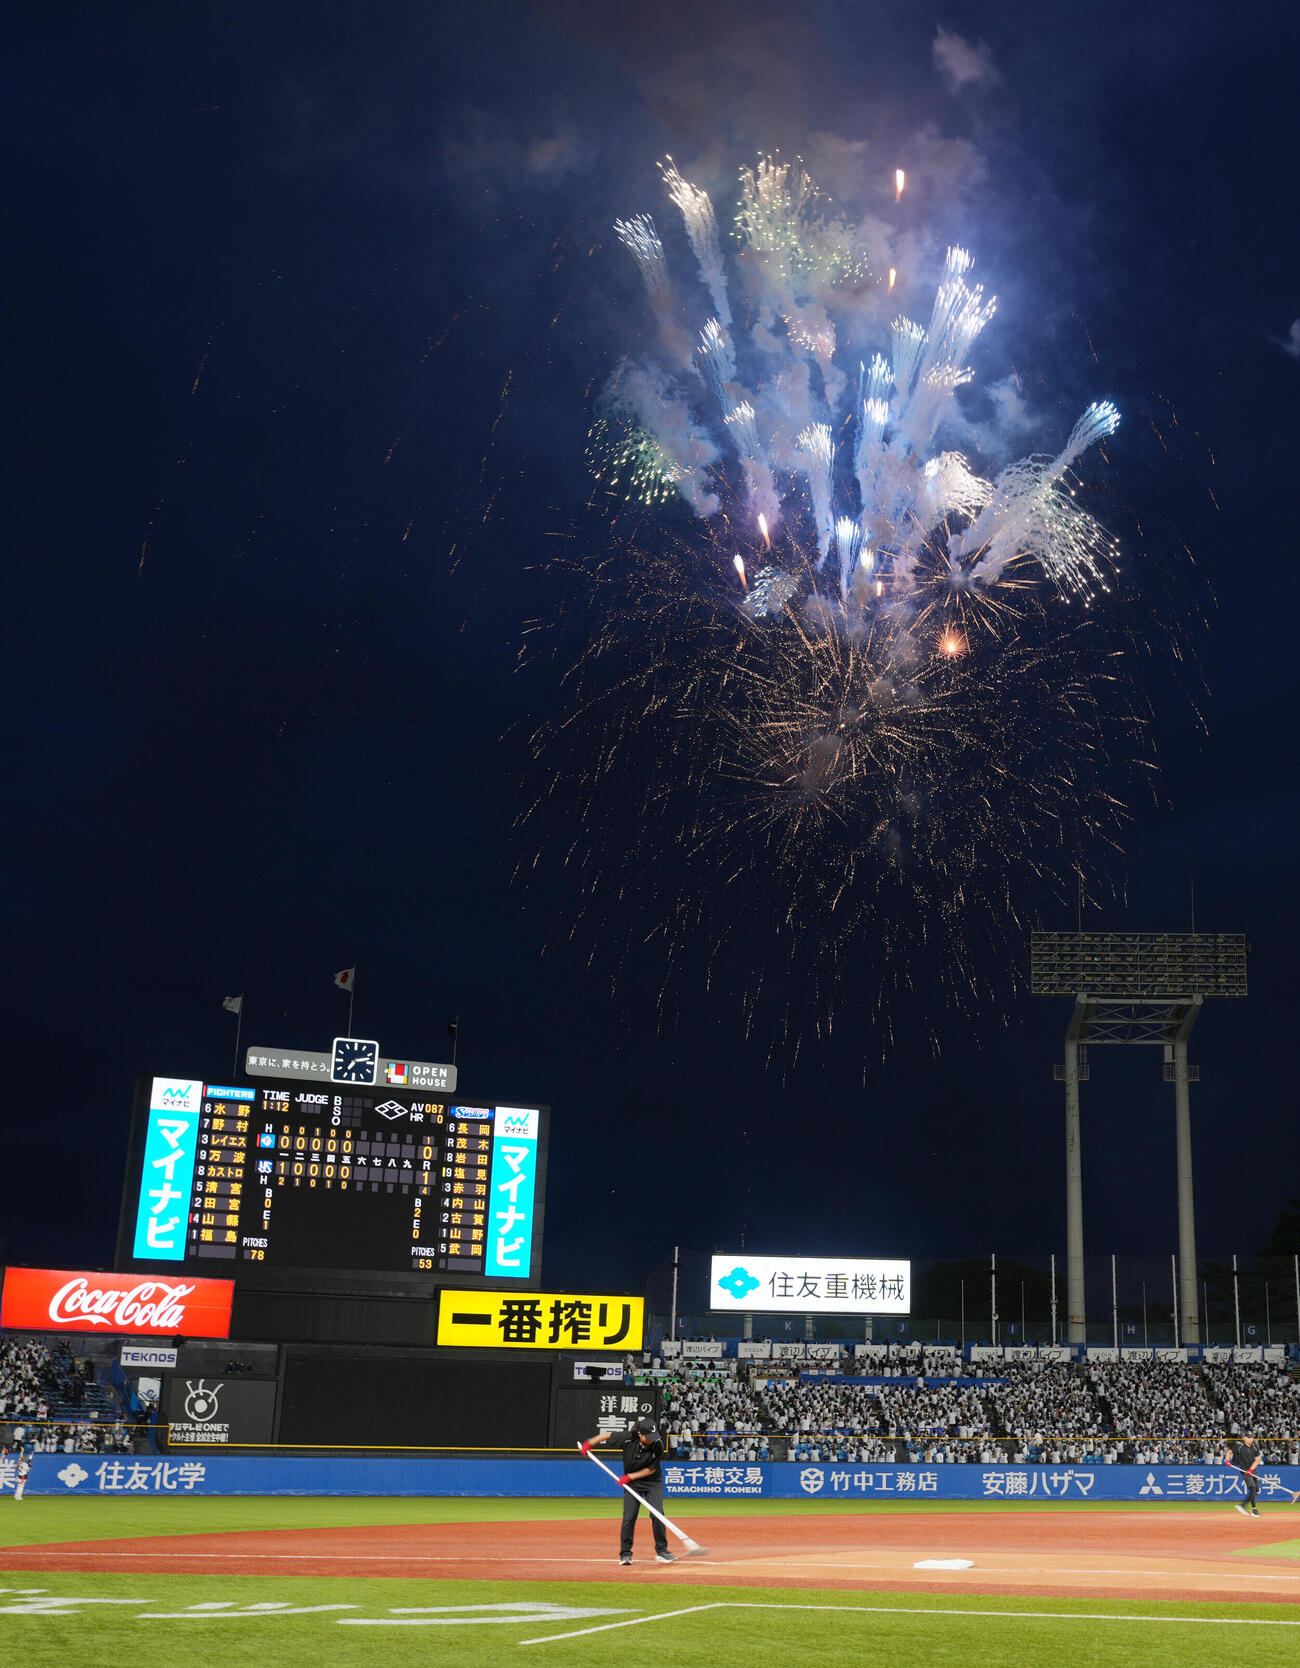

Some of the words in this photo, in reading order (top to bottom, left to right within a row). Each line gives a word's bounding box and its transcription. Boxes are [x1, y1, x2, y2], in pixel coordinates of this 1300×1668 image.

[412, 1065, 448, 1078] OPEN
[412, 1076, 447, 1087] HOUSE
[207, 1088, 254, 1099] FIGHTERS
[263, 1090, 290, 1102] TIME
[295, 1093, 329, 1105] JUDGE
[162, 1098, 190, 1108] マイナビ
[263, 1101, 290, 1112] 1:12
[334, 1096, 342, 1106] B
[204, 1103, 212, 1113] 6
[213, 1103, 250, 1117] 水野
[333, 1107, 341, 1116] S
[411, 1103, 424, 1112] AV
[425, 1104, 444, 1114] 087
[410, 1113, 423, 1122] HR
[437, 1115, 443, 1124] 0
[203, 1119, 210, 1129] 7
[211, 1118, 249, 1132] 野村
[265, 1123, 273, 1133] H
[283, 1125, 289, 1134] 0
[299, 1127, 305, 1135] 0
[330, 1129, 336, 1137] 0
[346, 1130, 351, 1138] 0
[449, 1123, 455, 1132] 6
[504, 1126, 529, 1135] マイナビ
[201, 1135, 209, 1145] 3
[211, 1134, 246, 1147] レイエス
[448, 1138, 454, 1147] R
[281, 1136, 289, 1148] 0
[296, 1137, 305, 1149] 0
[312, 1138, 320, 1151] 0
[327, 1139, 336, 1152] 0
[343, 1141, 352, 1153] 0
[423, 1146, 432, 1159] 0
[200, 1150, 207, 1160] 9
[447, 1153, 453, 1162] 8
[310, 1153, 320, 1162] 三
[342, 1156, 351, 1164] 五
[357, 1157, 366, 1165] 六
[373, 1158, 382, 1166] 七
[388, 1159, 396, 1167] 八
[403, 1160, 412, 1168] 九
[423, 1161, 431, 1170] R
[197, 1166, 205, 1176] 8
[207, 1165, 243, 1178] カストロ
[280, 1162, 285, 1174] 1
[294, 1163, 302, 1175] 0
[310, 1164, 318, 1176] 0
[326, 1165, 334, 1177] 0
[341, 1166, 349, 1178] 0
[422, 1171, 429, 1185] 1
[446, 1168, 452, 1177] 9
[147, 1118, 190, 1249] マイナビ
[196, 1181, 203, 1191] 5
[260, 1175, 268, 1185] H
[278, 1177, 284, 1185] 2
[310, 1179, 316, 1187] 0
[341, 1181, 347, 1189] 0
[444, 1183, 451, 1192] 3
[265, 1188, 272, 1197] B
[194, 1198, 202, 1208] 2
[264, 1198, 271, 1208] 0
[415, 1198, 421, 1207] B
[443, 1198, 450, 1207] 4
[452, 1198, 485, 1210] 内山
[496, 1145, 530, 1267] マイナビ
[263, 1210, 270, 1219] E
[414, 1208, 421, 1217] 2
[442, 1213, 448, 1222] 2
[192, 1214, 199, 1223] 4
[413, 1219, 420, 1228] E
[263, 1220, 268, 1230] 1
[192, 1229, 197, 1240] 1
[413, 1229, 419, 1238] 0
[442, 1228, 446, 1238] 1
[450, 1228, 483, 1240] 山野
[242, 1237, 268, 1248] PITCHES
[411, 1246, 435, 1256] PITCHES
[440, 1244, 446, 1253] 5
[250, 1249, 265, 1260] 78
[419, 1259, 432, 1269] 53
[769, 1271, 905, 1301] 住友重機械
[49, 1278, 196, 1328] Coca-Cola
[1127, 1326, 1135, 1334] H
[1248, 1326, 1256, 1335] G
[122, 1352, 176, 1363] TEKNOS
[600, 1395, 653, 1413] 洋服の
[95, 1461, 206, 1490] 住友化学
[665, 1467, 764, 1485] 高千穂交易
[830, 1471, 938, 1492] 竹中工務店
[982, 1469, 1095, 1496] 安藤ハザマ
